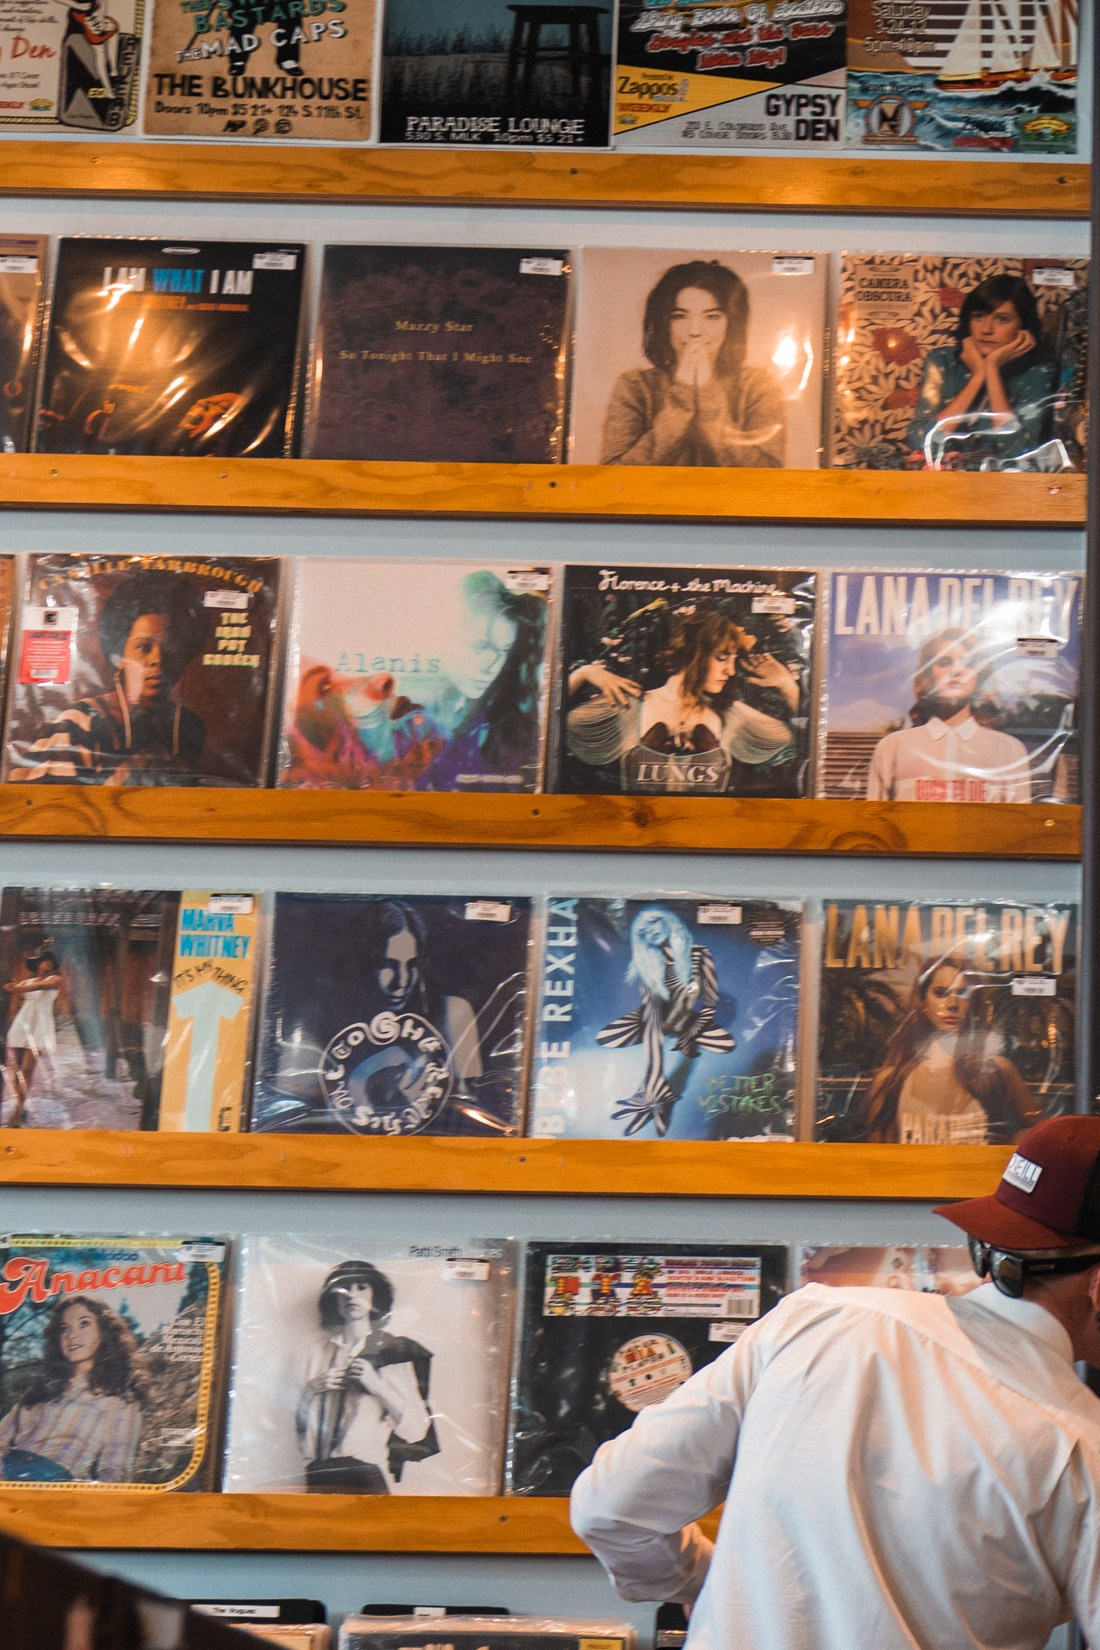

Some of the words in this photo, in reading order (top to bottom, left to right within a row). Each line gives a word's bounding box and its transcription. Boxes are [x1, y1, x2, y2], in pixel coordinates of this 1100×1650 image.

[194, 0, 346, 34] BASTARDS
[10, 34, 57, 59] Den
[201, 34, 260, 59] MAD
[269, 19, 347, 48] CAPS
[153, 73, 204, 97] THE
[211, 74, 369, 101] BUNKHOUSE
[618, 76, 681, 101] Zappos
[766, 94, 842, 117] GYPSY
[405, 132, 431, 141] 530
[536, 134, 553, 143] $5
[406, 116, 501, 132] PARADISE
[508, 118, 586, 134] LOUNGE
[795, 119, 840, 142] DEN
[152, 268, 205, 293] WHAT
[210, 270, 220, 294] I
[222, 270, 254, 295] AM
[394, 320, 440, 334] Mazzy
[444, 320, 474, 332] Star
[338, 350, 357, 361] So
[361, 350, 412, 363] Tonight
[417, 351, 448, 362] That
[452, 352, 458, 362] I
[463, 353, 503, 365] Might
[508, 354, 533, 364] See
[598, 569, 666, 592] Florence
[681, 580, 711, 592] the
[713, 579, 784, 595] Machine
[834, 575, 932, 636] LANA
[336, 652, 441, 674] Alanis
[637, 764, 719, 783] LUNGS
[825, 904, 923, 969] LANA
[931, 907, 994, 971] DEL
[1002, 908, 1071, 974] REY
[543, 899, 579, 1022] REXHA
[408, 1246, 432, 1257] Patti
[433, 1246, 463, 1258] Smith
[0, 1257, 190, 1315] Anacani
